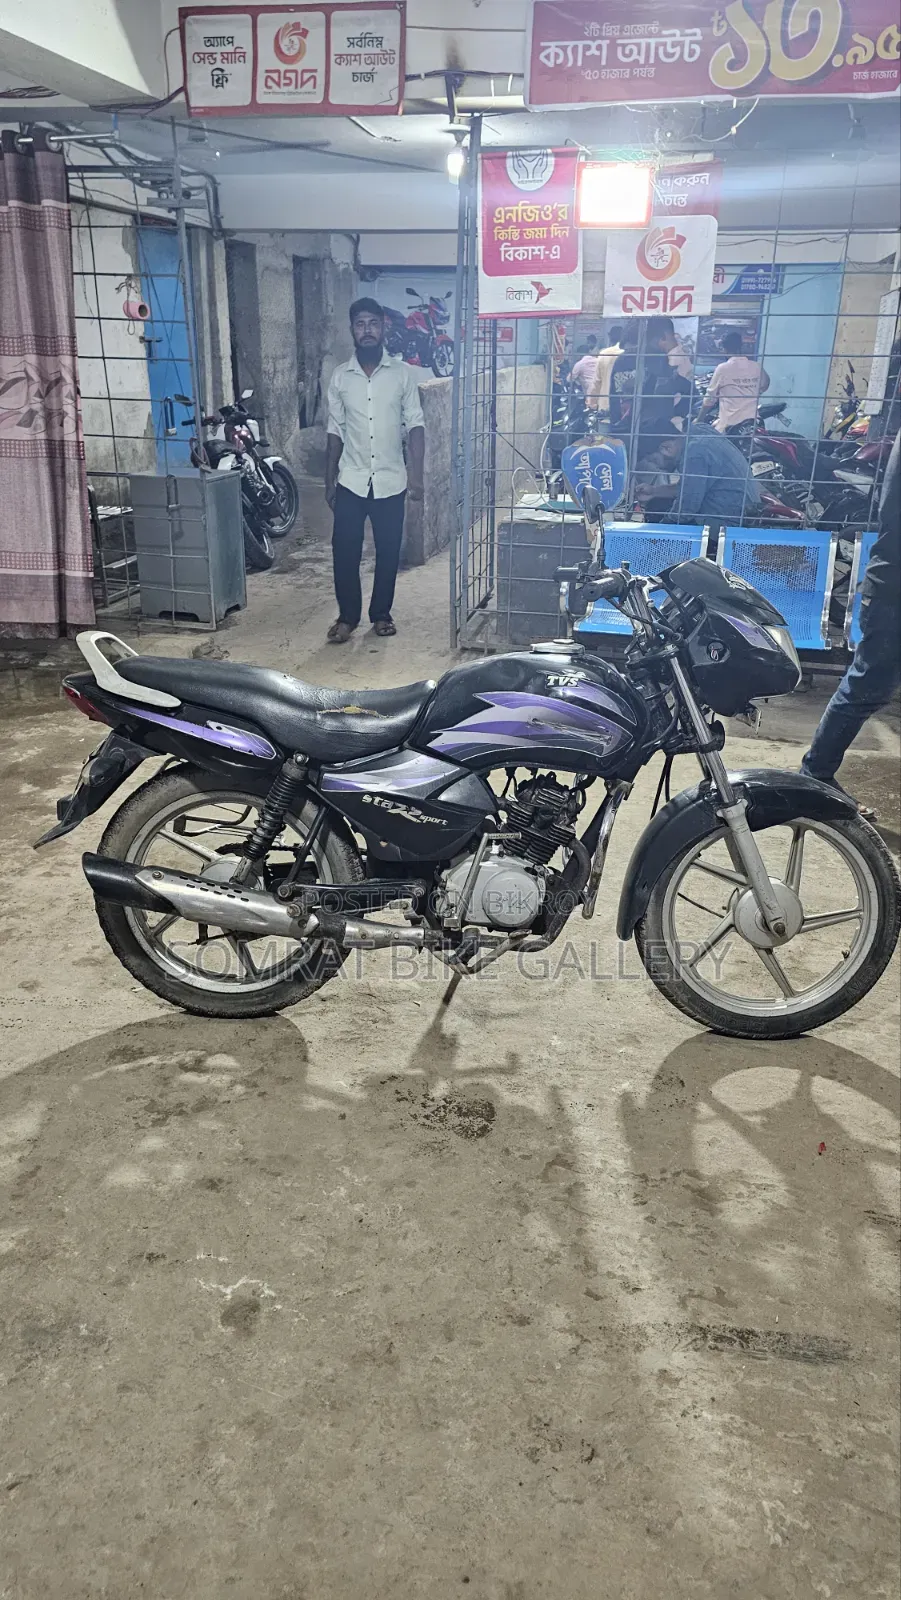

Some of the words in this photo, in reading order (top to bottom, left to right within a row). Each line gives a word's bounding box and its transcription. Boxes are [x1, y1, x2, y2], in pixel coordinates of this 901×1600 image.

[203, 36, 234, 48] অ্যাপে
[539, 39, 610, 68] ক্যাশ
[616, 28, 703, 65] আউট
[192, 51, 217, 65] সেন্ড
[220, 46, 247, 64] মানি
[334, 53, 361, 66] ক্যাশ
[364, 49, 396, 66] আউট
[264, 68, 318, 90] নগদ
[351, 67, 377, 83] চার্জ
[673, 173, 711, 188] করুন
[522, 227, 548, 240] জমা
[550, 223, 570, 239] দিন
[499, 242, 560, 262] বিকাশ-এ
[506, 286, 533, 301] বিকাশ
[622, 285, 695, 314] নগদ
[547, 675, 579, 687] TVS
